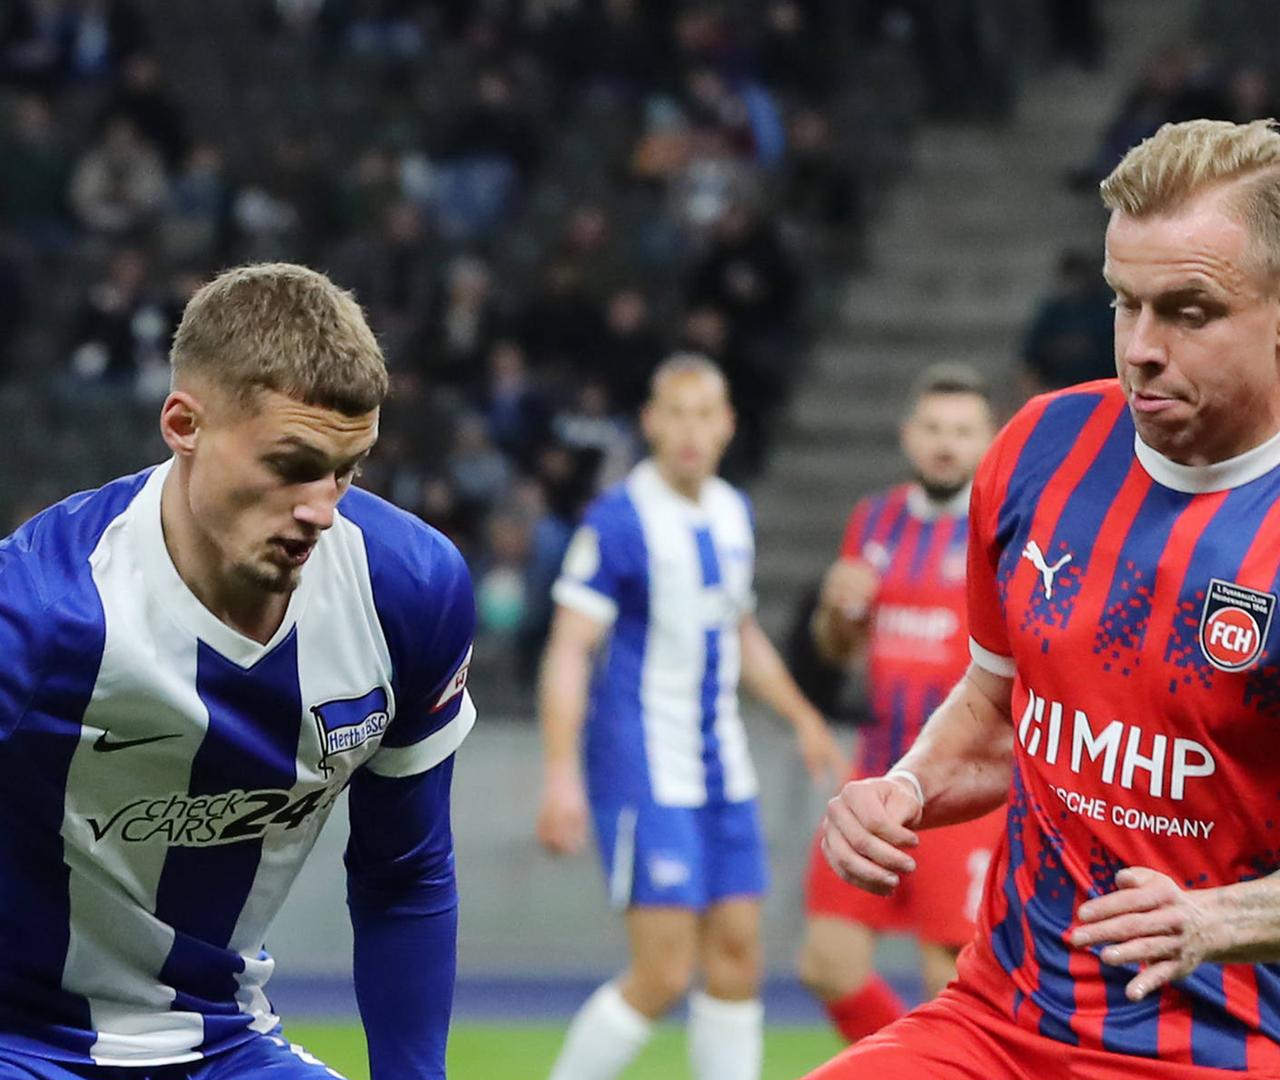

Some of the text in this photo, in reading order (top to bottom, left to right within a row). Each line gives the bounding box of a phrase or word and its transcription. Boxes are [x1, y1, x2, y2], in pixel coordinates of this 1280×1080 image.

[1209, 620, 1253, 654] FCH
[1070, 709, 1216, 801] MHP
[121, 816, 223, 842] CARS
[219, 786, 327, 840] 24
[145, 794, 241, 819] check
[1111, 805, 1216, 840] COMPANY
